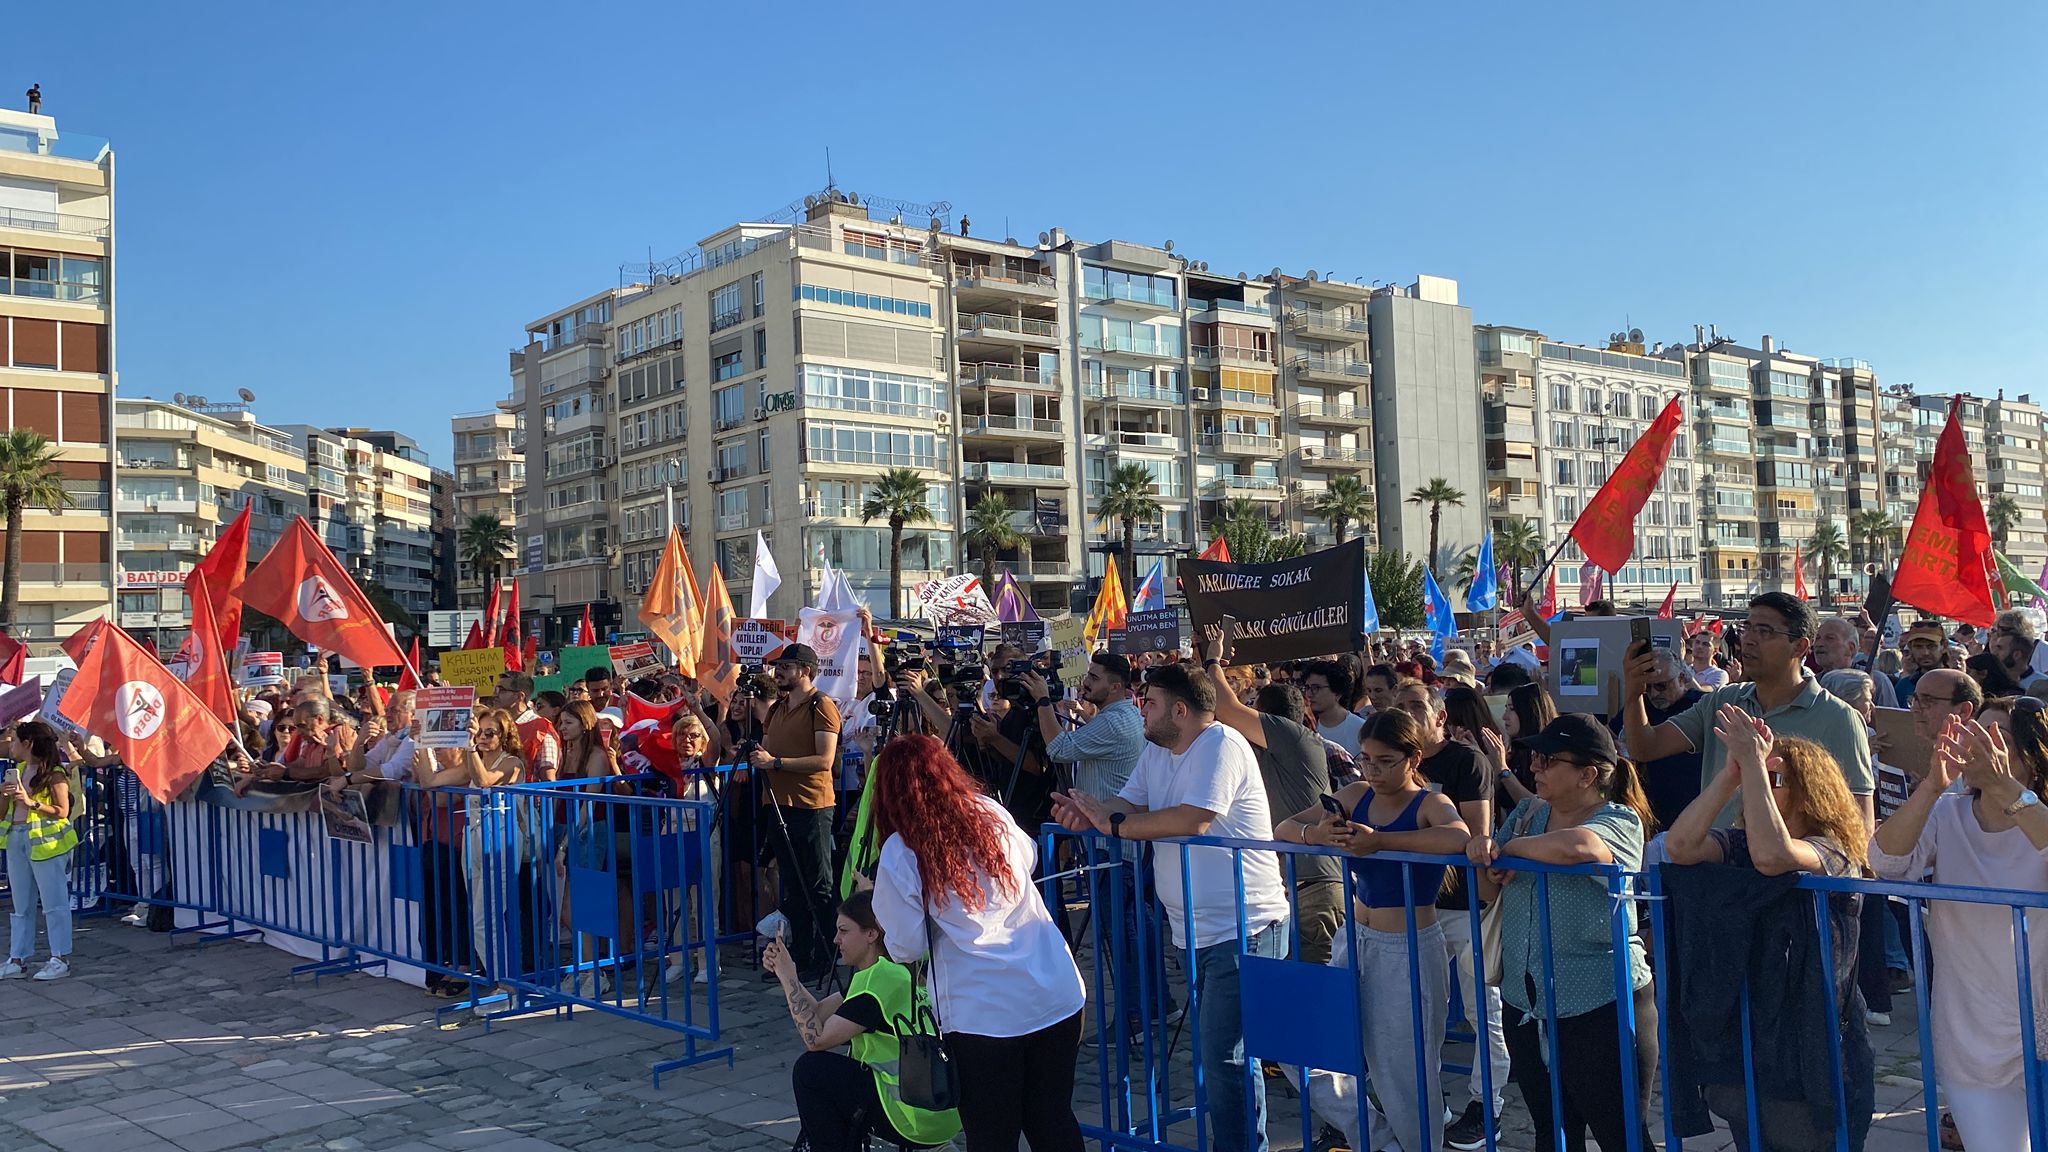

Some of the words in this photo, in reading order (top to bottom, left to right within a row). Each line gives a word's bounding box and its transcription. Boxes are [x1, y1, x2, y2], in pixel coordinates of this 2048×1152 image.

[1198, 573, 1263, 593] NARLIDERE
[1269, 566, 1312, 588] SOKAK
[920, 579, 943, 604] SOKAK
[1126, 613, 1158, 622] UNUTMA
[1159, 610, 1177, 619] BENİ
[1269, 601, 1348, 636] GÖNÜLLÜLERİ
[1127, 623, 1158, 632] UYUTMA
[736, 633, 767, 644] KATİLLERİ
[740, 646, 763, 656] TOPLA!
